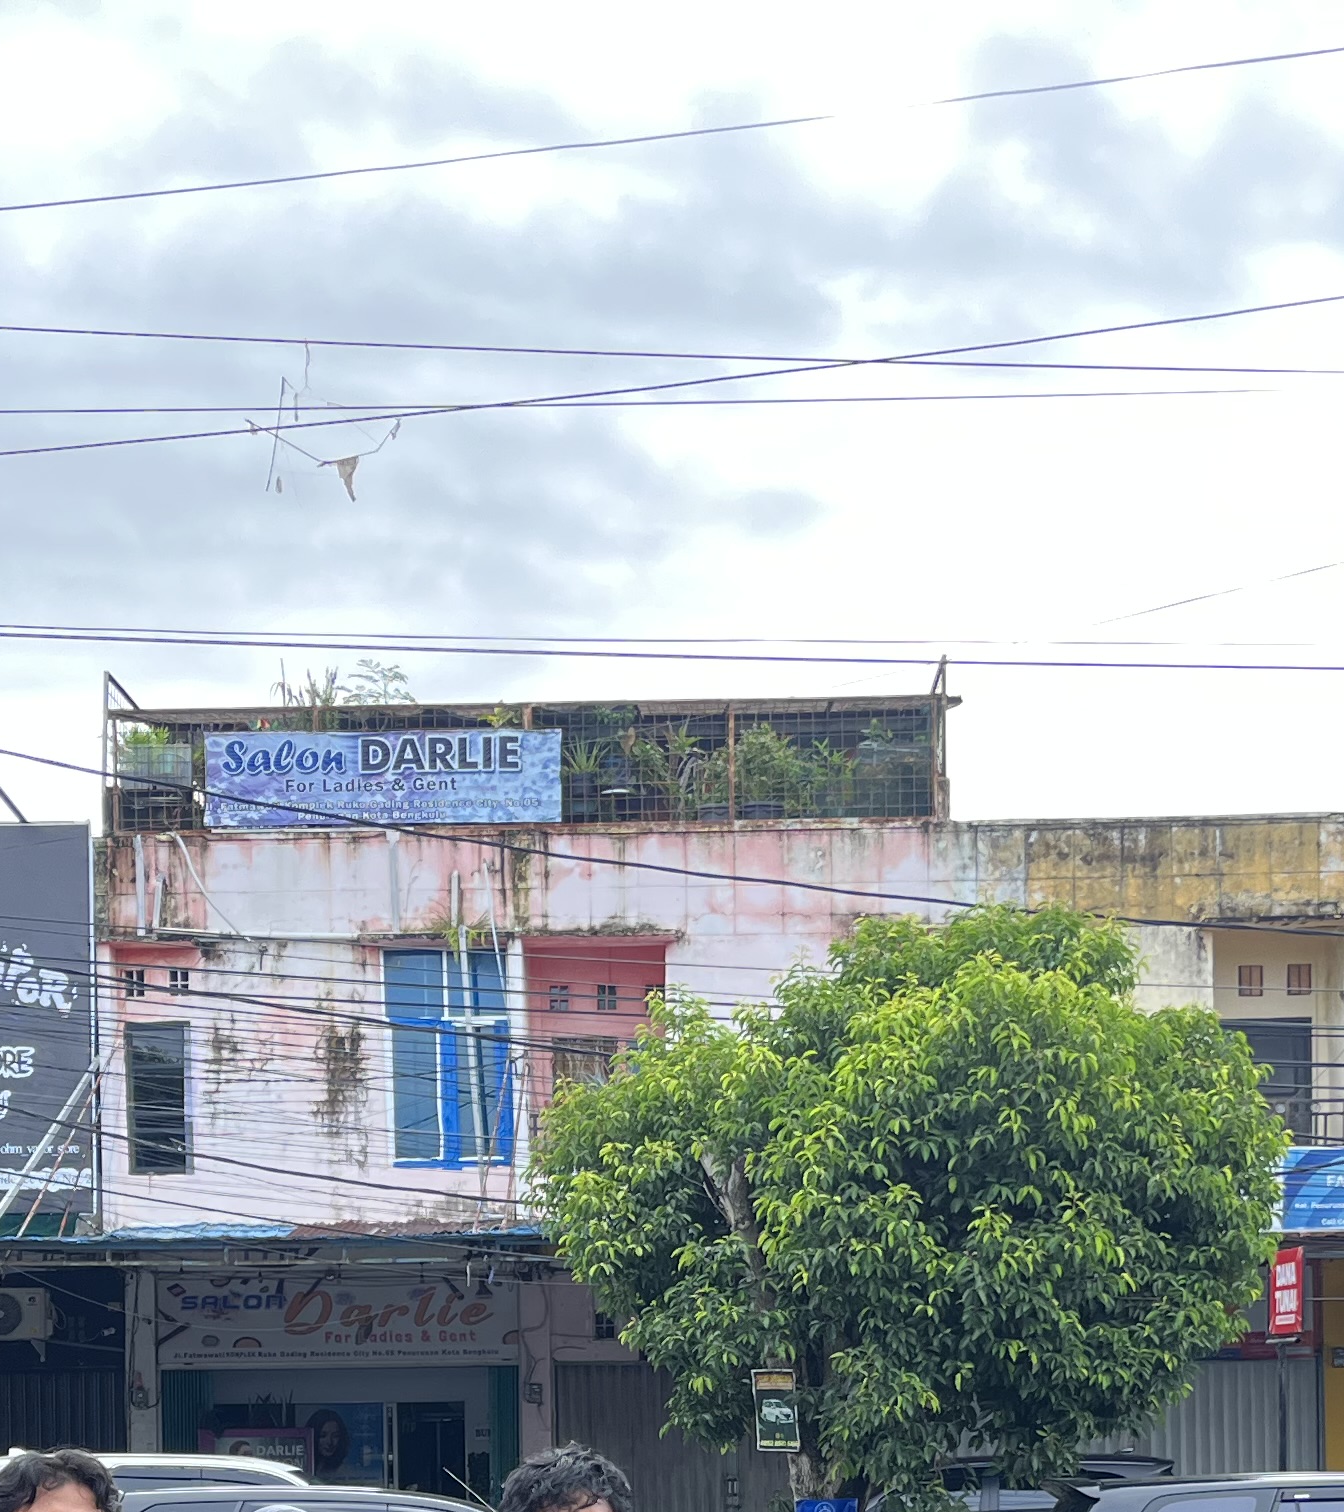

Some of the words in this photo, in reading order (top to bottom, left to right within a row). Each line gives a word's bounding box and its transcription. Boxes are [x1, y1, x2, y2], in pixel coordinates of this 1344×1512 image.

[221, 738, 346, 776] Salon
[358, 734, 523, 774] DARLIE
[285, 779, 315, 793] For
[322, 777, 384, 793] Ladies
[391, 779, 406, 793] &
[413, 778, 457, 792] Gent
[363, 812, 388, 820] Kota
[392, 811, 447, 820] Bengkulu
[181, 1295, 288, 1310] SALON
[284, 1286, 494, 1335] Darlie
[324, 1331, 352, 1344] For
[366, 1330, 413, 1344] adies
[420, 1332, 432, 1343] &
[438, 1330, 477, 1343] Gent
[256, 1444, 305, 1456] DARLIE
